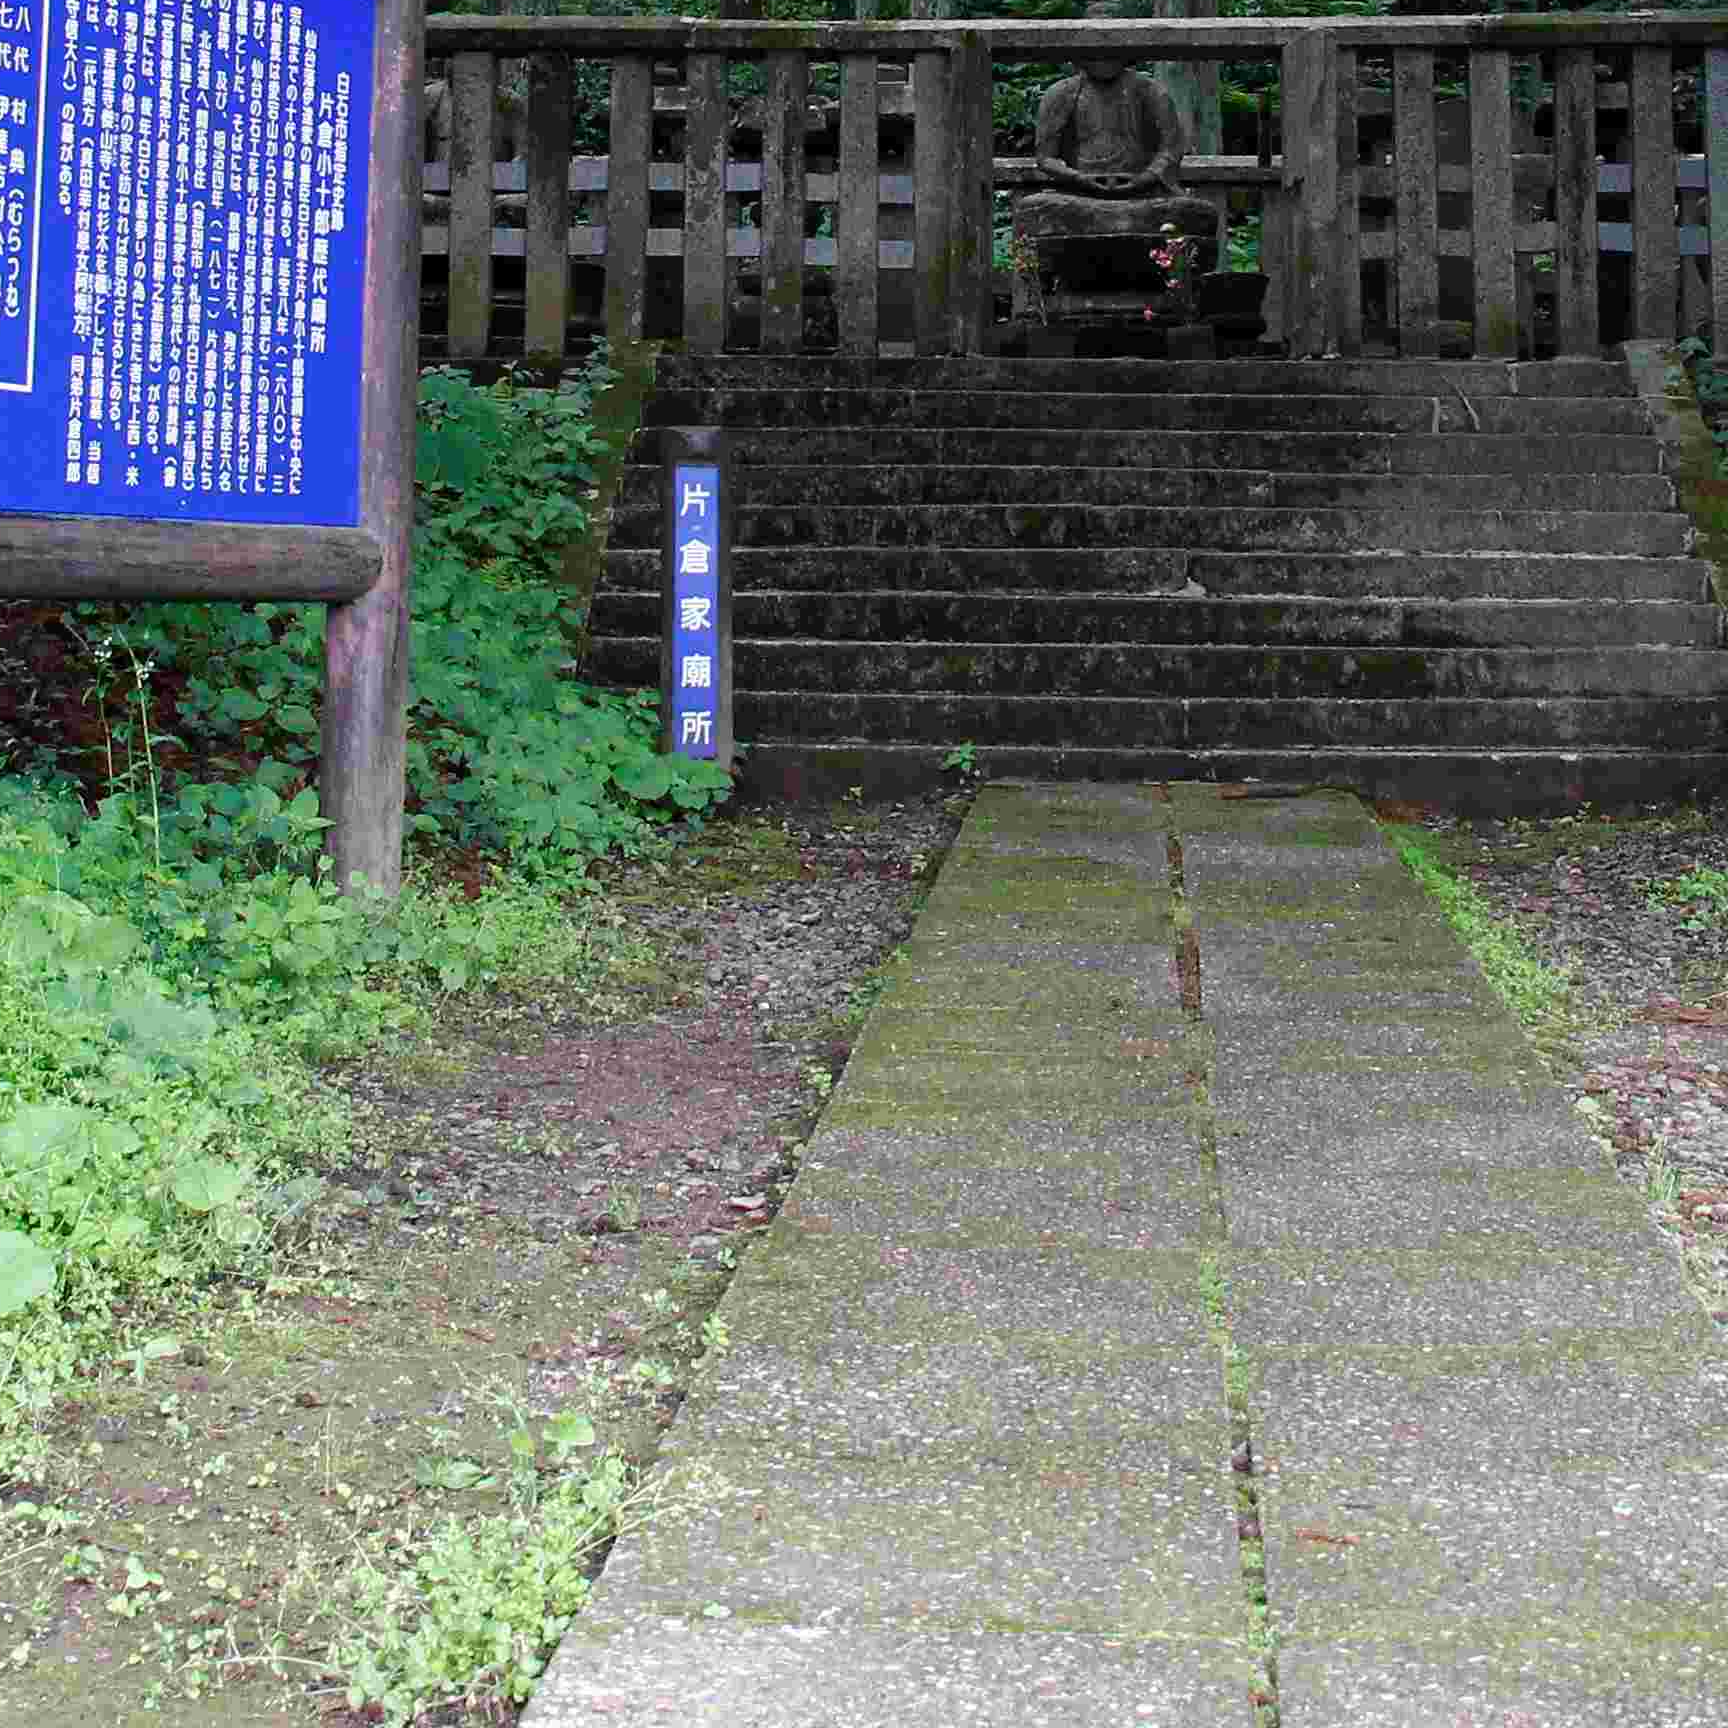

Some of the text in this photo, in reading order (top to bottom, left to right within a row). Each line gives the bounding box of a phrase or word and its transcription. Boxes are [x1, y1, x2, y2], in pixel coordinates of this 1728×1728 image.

[310, 91, 334, 353] 片倉小十郎歴代廟所
[331, 71, 351, 232] 白石市指定史跡
[679, 483, 712, 745] 片倉家廟所
